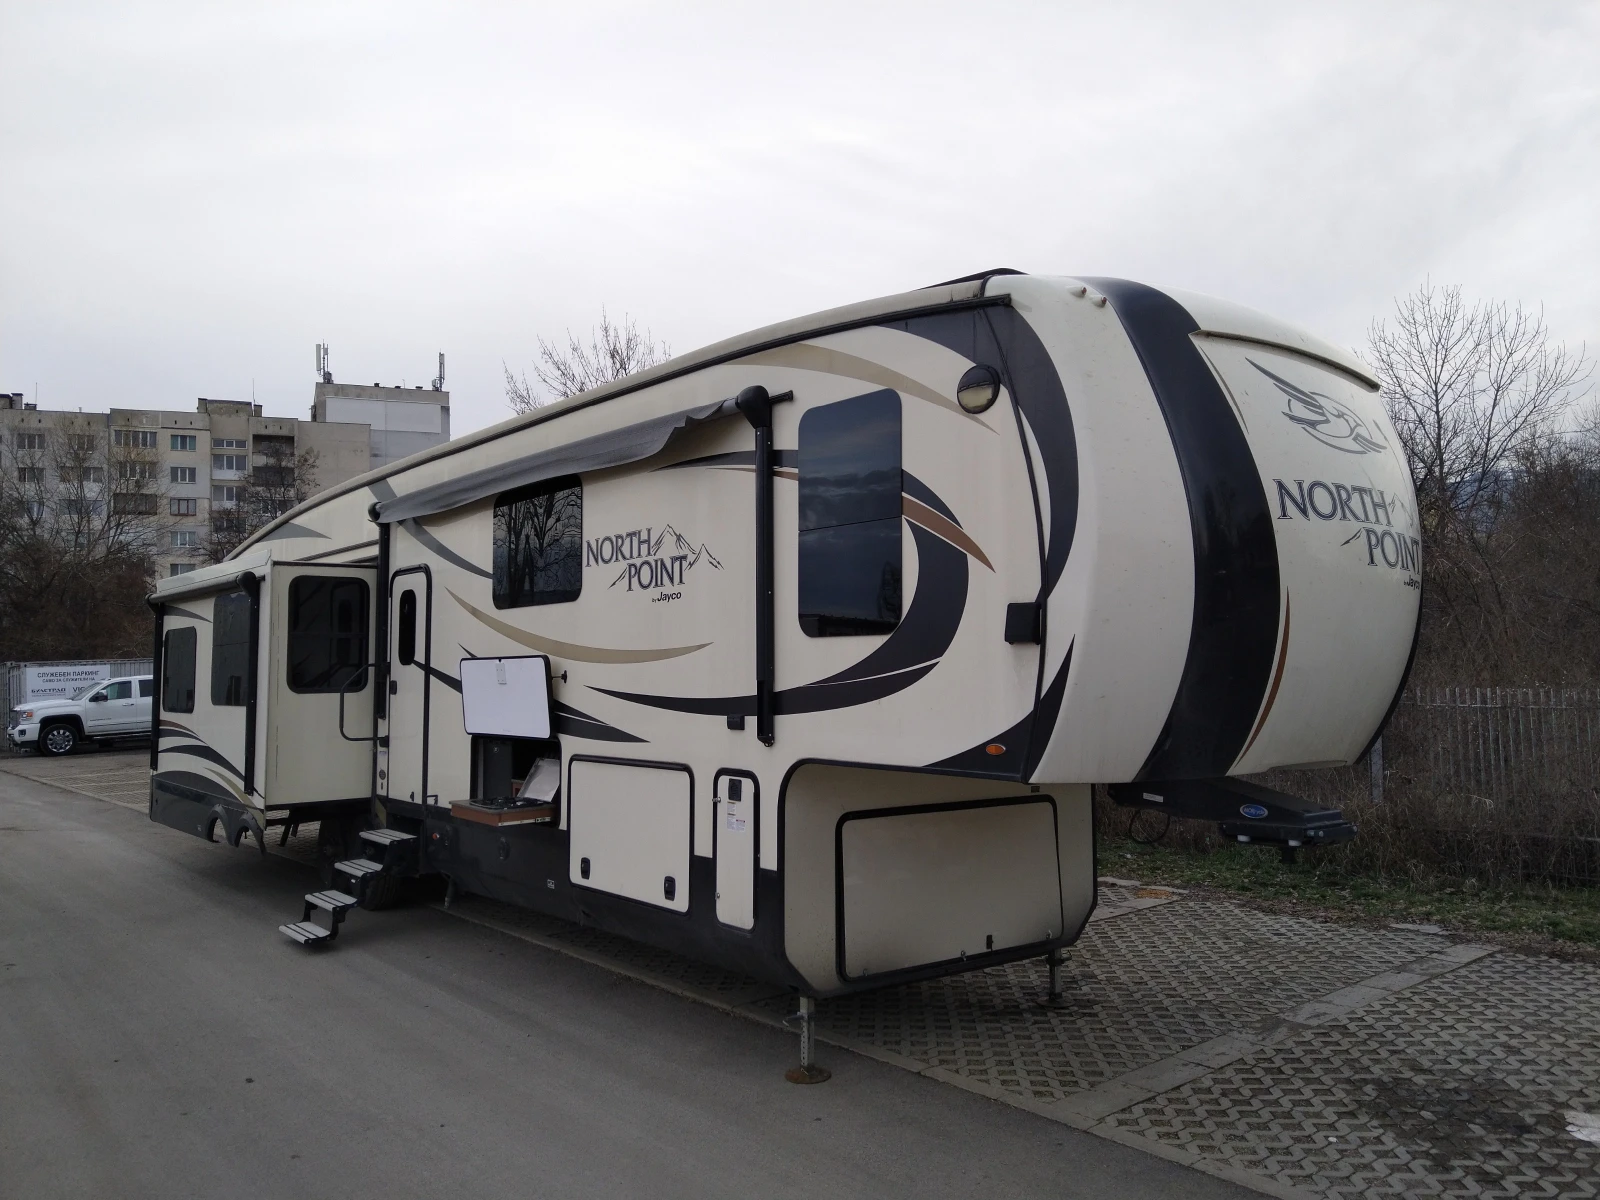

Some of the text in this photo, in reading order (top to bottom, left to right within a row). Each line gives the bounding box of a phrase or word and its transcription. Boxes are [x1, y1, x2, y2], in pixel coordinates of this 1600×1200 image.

[1272, 478, 1394, 527] NORTH
[585, 527, 653, 568] NORTH
[1362, 526, 1420, 576] POINT
[626, 553, 689, 593] POINT
[657, 591, 682, 603] Jayco
